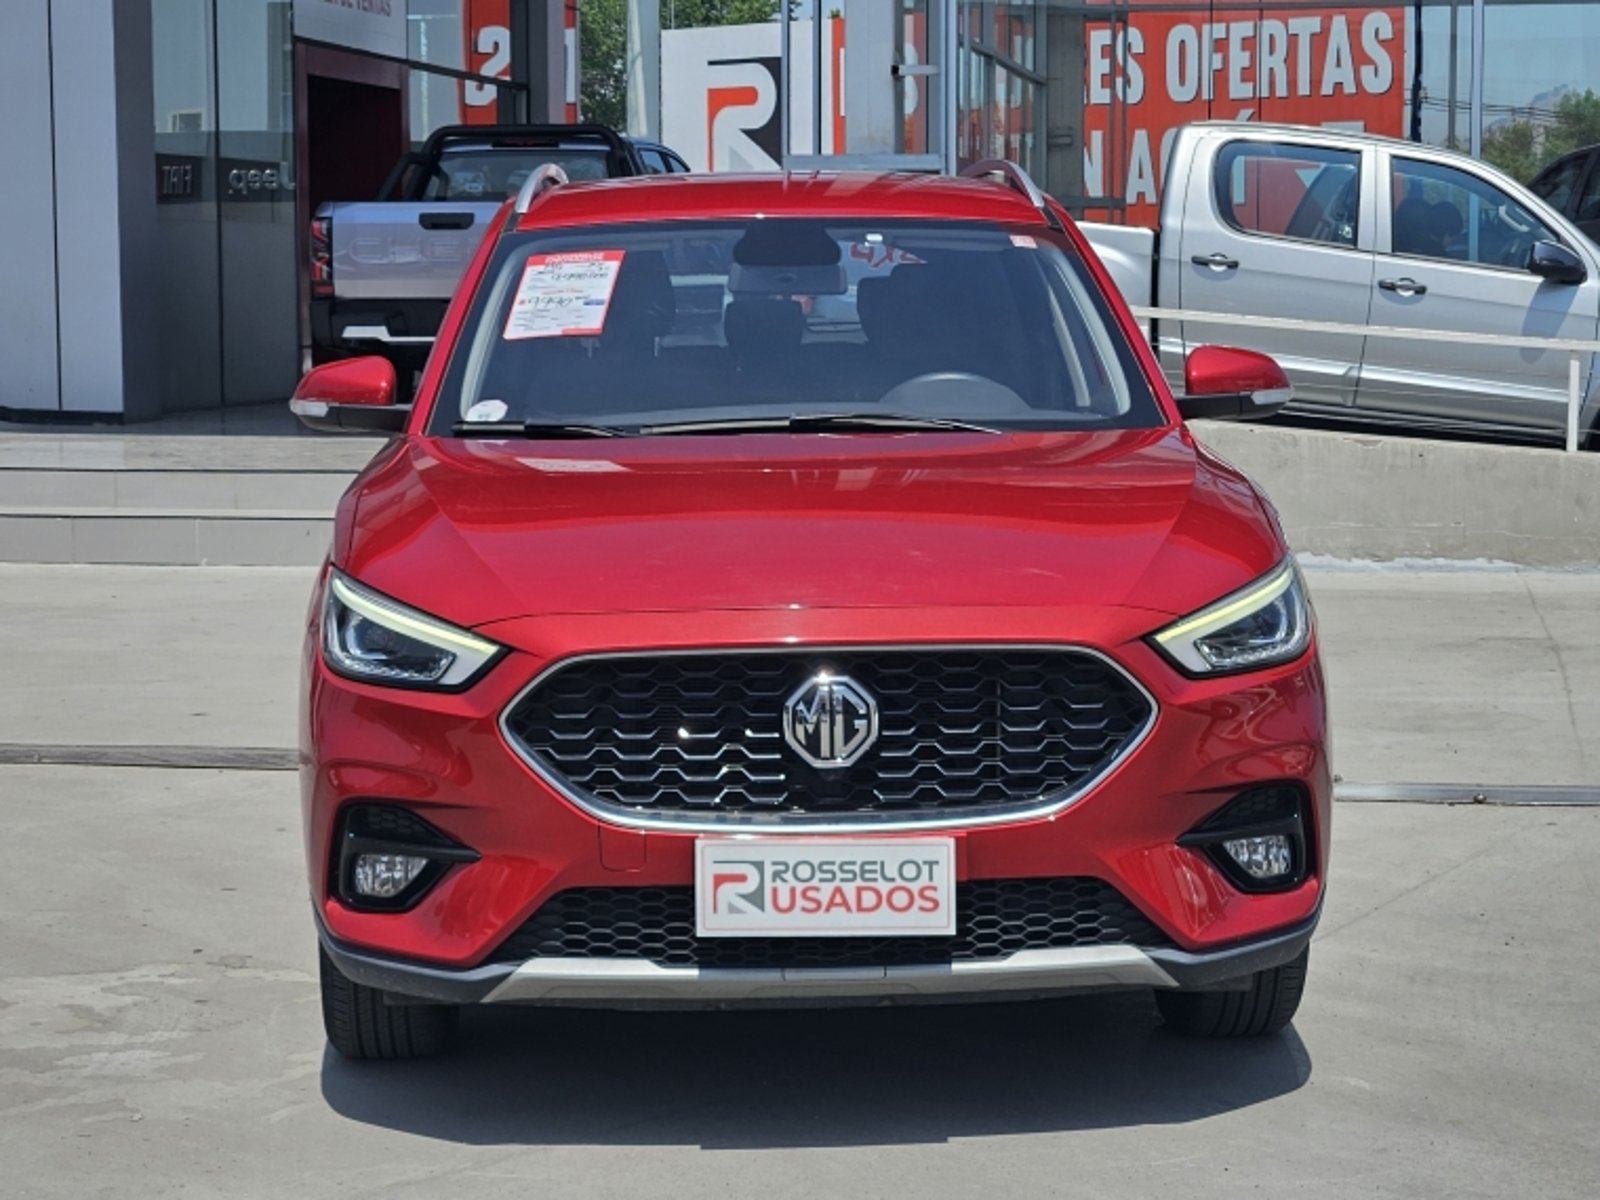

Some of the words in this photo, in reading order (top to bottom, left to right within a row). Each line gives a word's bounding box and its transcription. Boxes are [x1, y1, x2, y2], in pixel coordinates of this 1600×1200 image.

[1084, 27, 1145, 105] ES
[1165, 11, 1395, 104] OFERTAS
[795, 683, 869, 759] MG
[770, 860, 940, 884] ROSSELOT
[771, 885, 940, 914] USADOS
